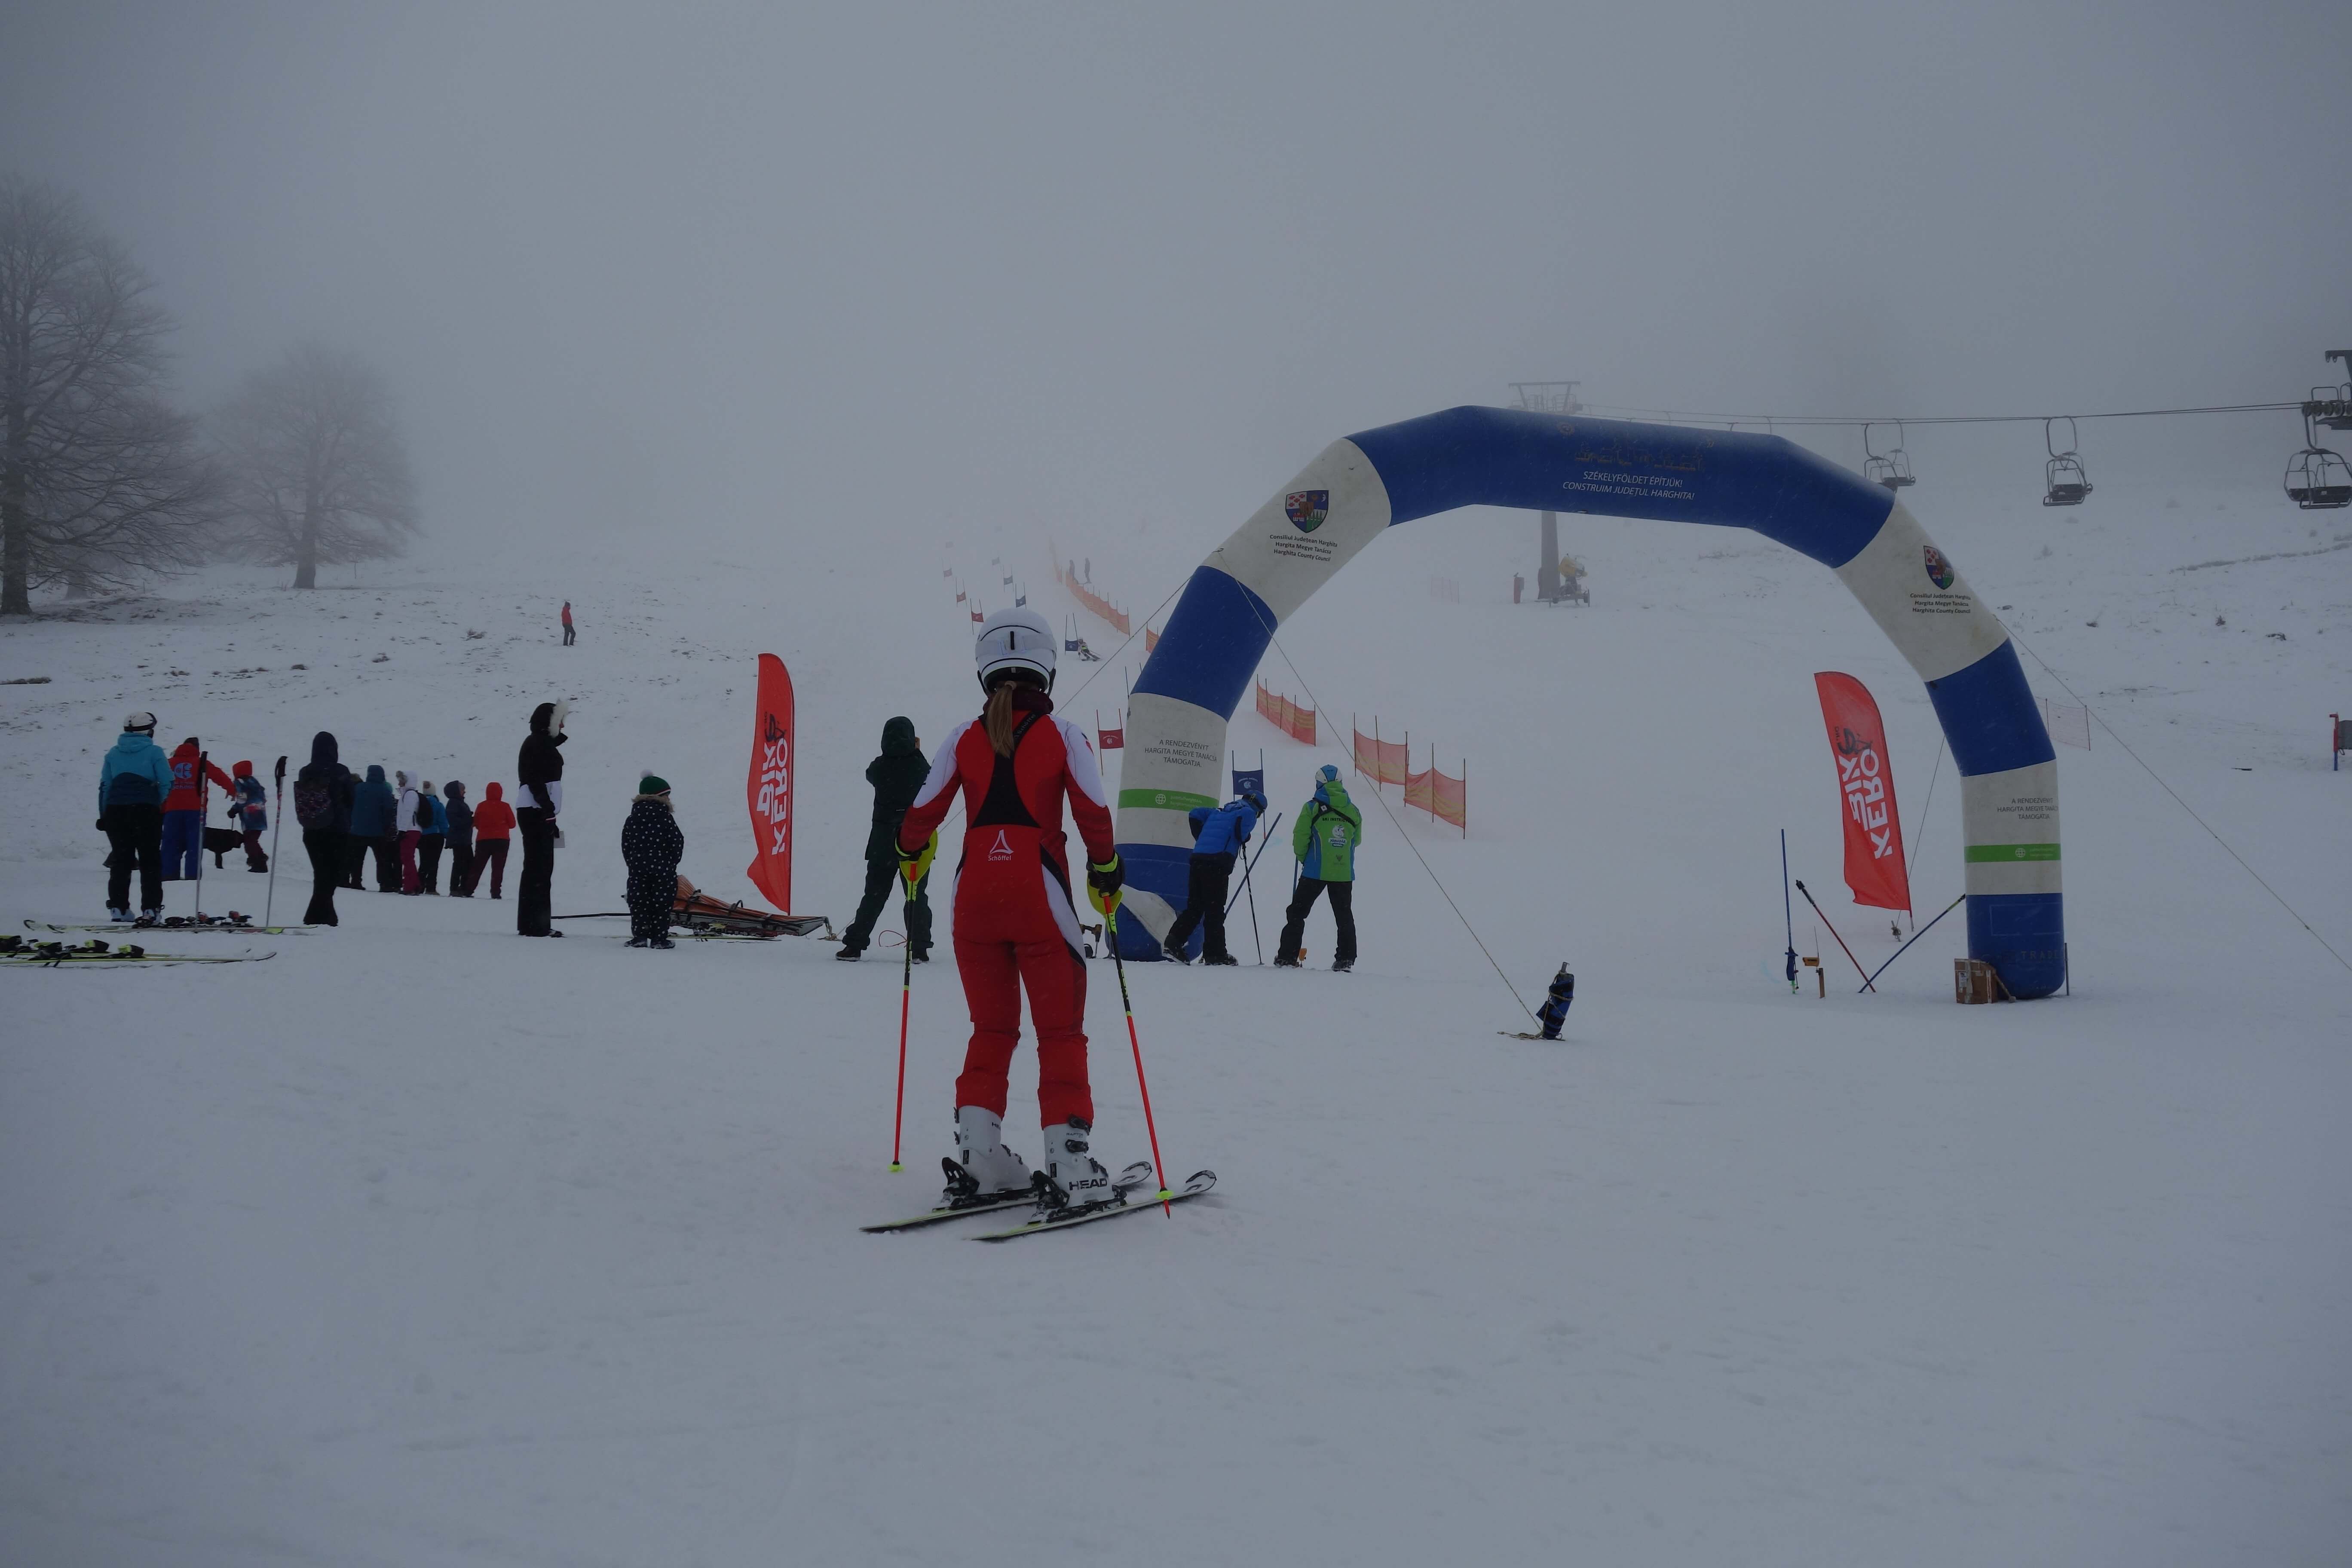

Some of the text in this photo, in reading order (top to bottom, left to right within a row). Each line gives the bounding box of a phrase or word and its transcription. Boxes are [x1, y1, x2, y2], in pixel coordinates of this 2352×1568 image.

[1583, 471, 1683, 488] SZÉKELYFÖLDET ÉPÍTJÜK!
[1563, 481, 1612, 493] CONSTRUIM
[1651, 489, 1695, 500] HARGHITA!
[1165, 740, 1209, 750] RENDEZVÉNYT
[1196, 752, 1217, 762] TANÁCSA
[1069, 1178, 1108, 1191] HEAD
